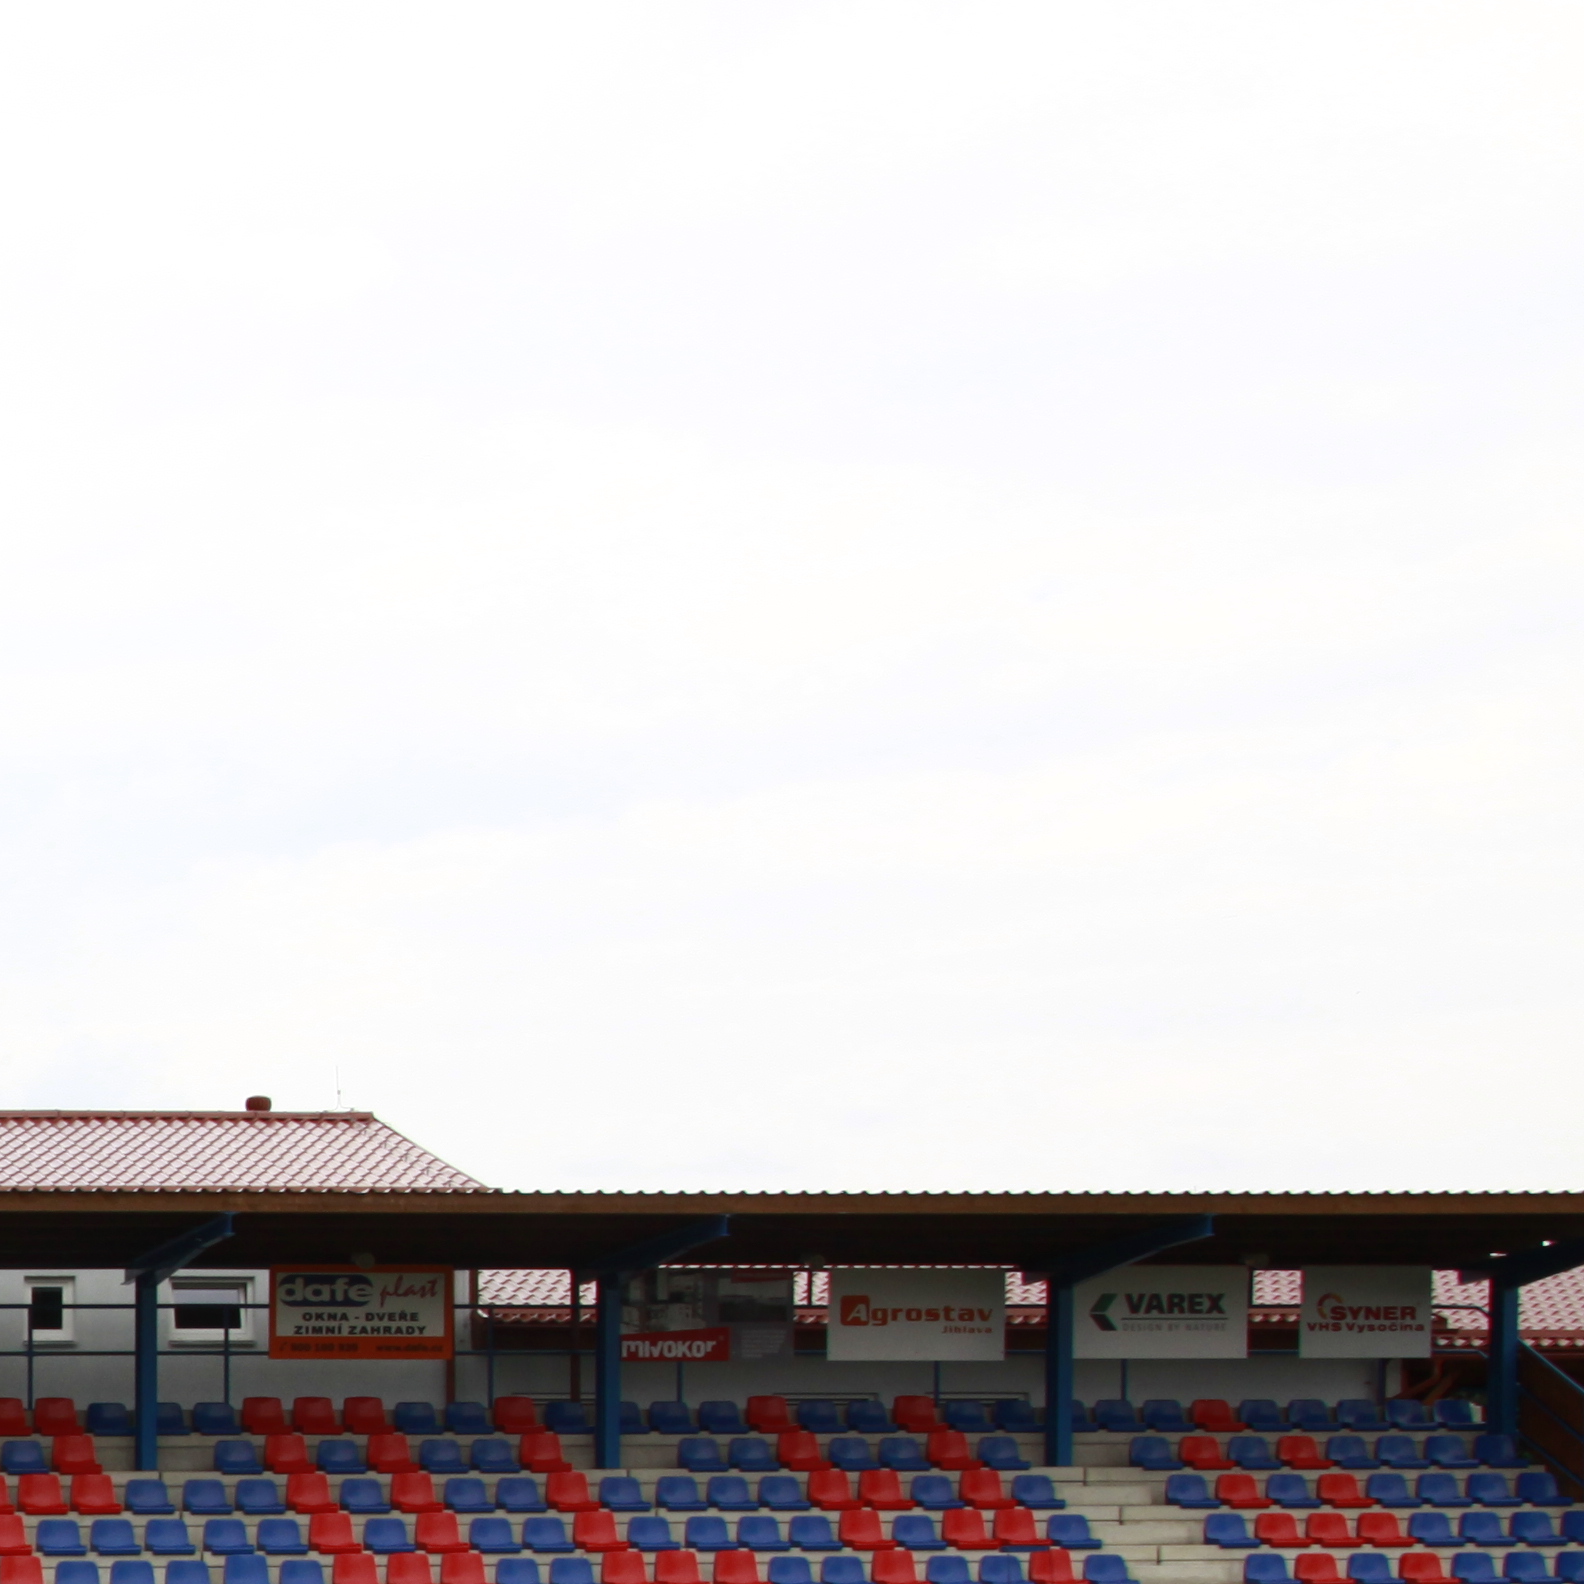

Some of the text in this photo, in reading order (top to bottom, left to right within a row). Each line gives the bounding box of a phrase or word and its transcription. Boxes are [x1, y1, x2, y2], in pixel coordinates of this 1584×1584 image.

[278, 1275, 438, 1307] dafe plast
[1124, 1293, 1226, 1314] VAREX
[302, 1312, 349, 1322] OKNA
[365, 1310, 419, 1322] DVEŘE
[844, 1300, 993, 1326] Agrostav
[1330, 1306, 1416, 1320] SYNER
[294, 1323, 426, 1335] ZIMNÍ ZAHRADY
[942, 1326, 993, 1334] Jihlava
[1122, 1322, 1227, 1331] DESIGN BY NATURE
[1307, 1322, 1425, 1333] VHS Vysočina
